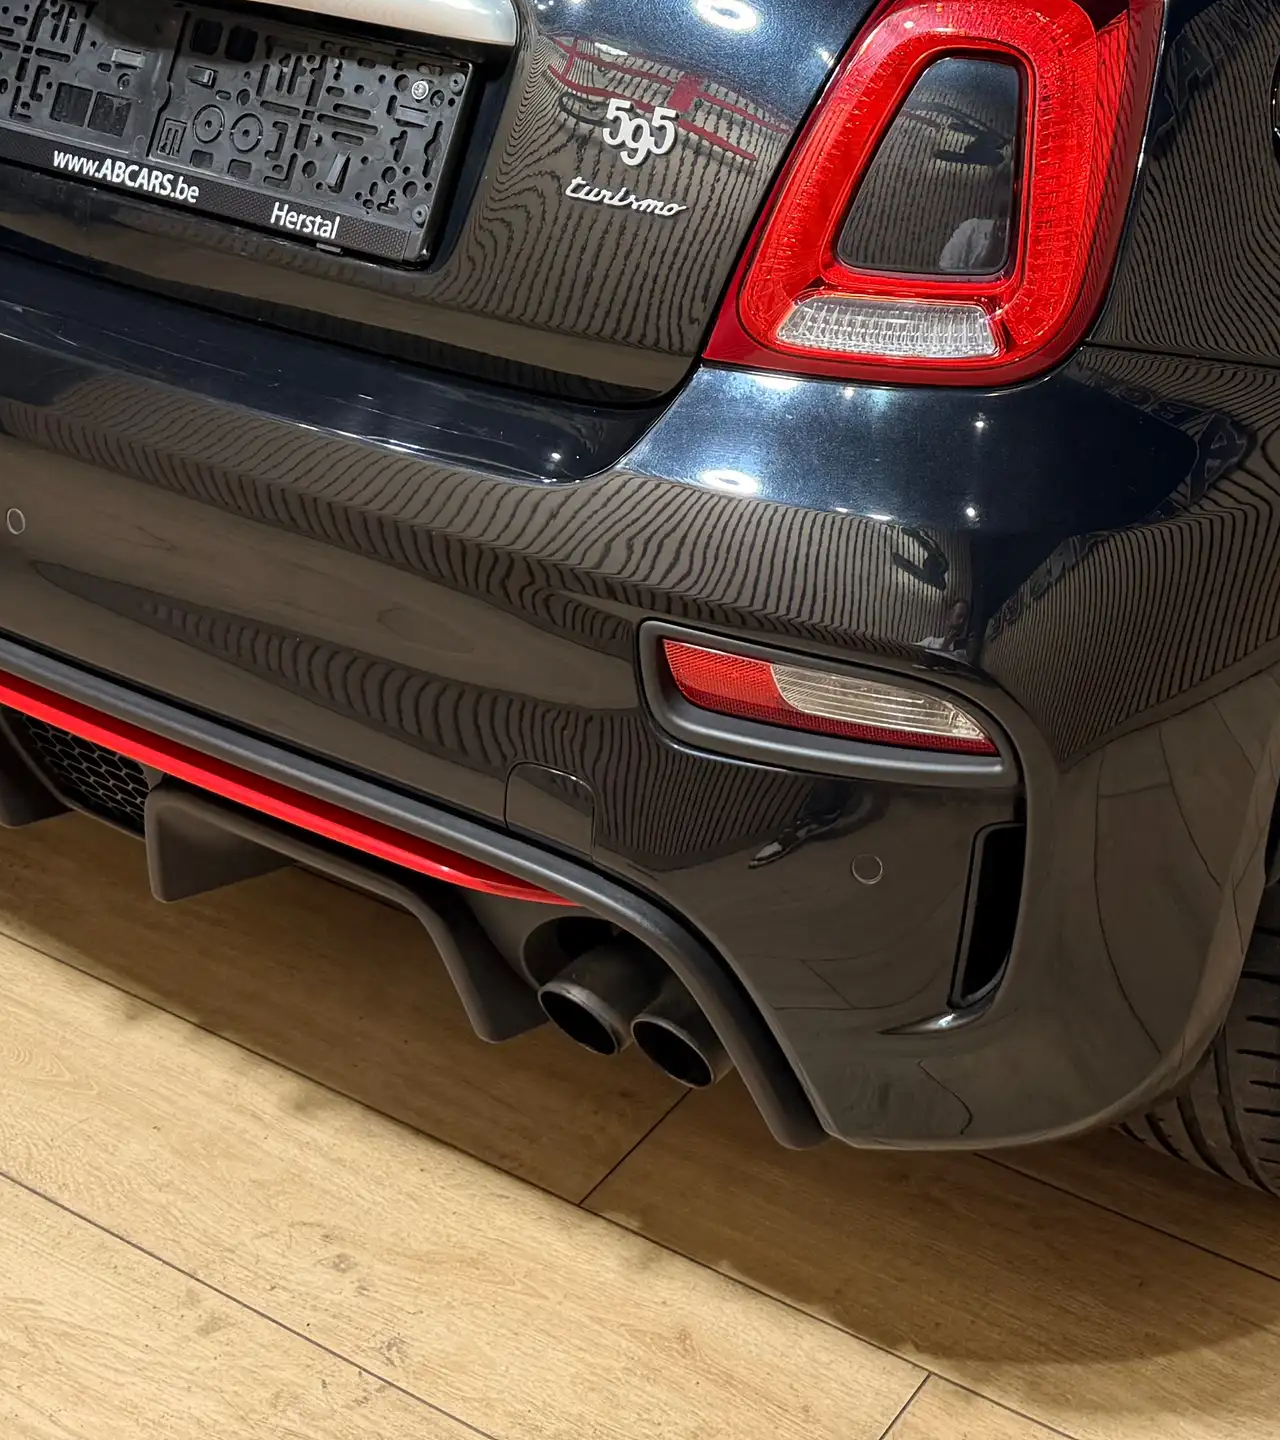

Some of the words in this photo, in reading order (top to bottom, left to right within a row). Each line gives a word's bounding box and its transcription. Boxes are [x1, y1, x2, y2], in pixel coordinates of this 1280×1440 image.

[603, 98, 676, 166] 595
[53, 149, 200, 203] www.ABCARS.be
[565, 176, 687, 216] turismo
[270, 200, 341, 240] Herstal
